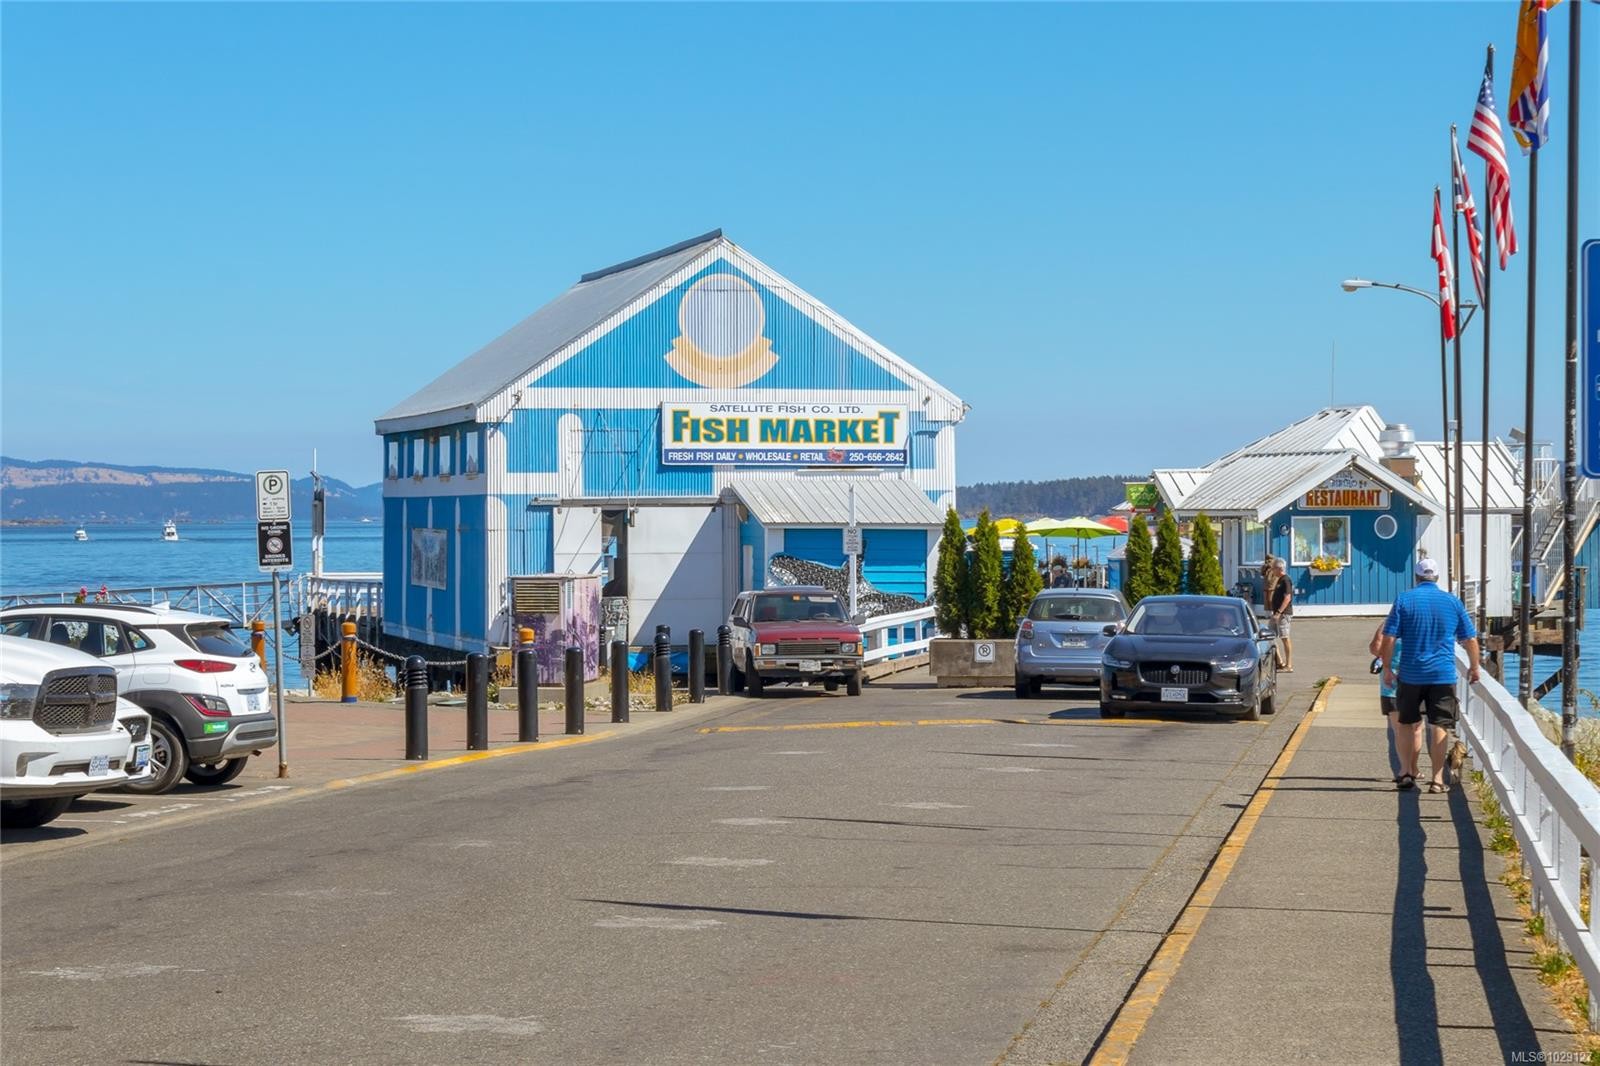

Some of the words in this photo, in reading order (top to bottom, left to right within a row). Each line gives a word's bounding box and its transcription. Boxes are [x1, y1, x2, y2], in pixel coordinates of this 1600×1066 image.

[710, 404, 773, 413] SATELLITE
[778, 405, 806, 414] FISH
[811, 405, 833, 414] CO.
[839, 405, 864, 414] LTD.
[672, 409, 750, 443] FISH
[758, 410, 900, 444] MARKET
[668, 452, 694, 461] FRESH
[696, 452, 714, 461] FISH
[716, 452, 737, 461] DAILY
[745, 452, 791, 461] WHOLESALE
[800, 452, 825, 461] RETAIL
[849, 452, 904, 461] 250-656-2642
[268, 479, 278, 491] P
[1306, 489, 1381, 506] RESTAURANT
